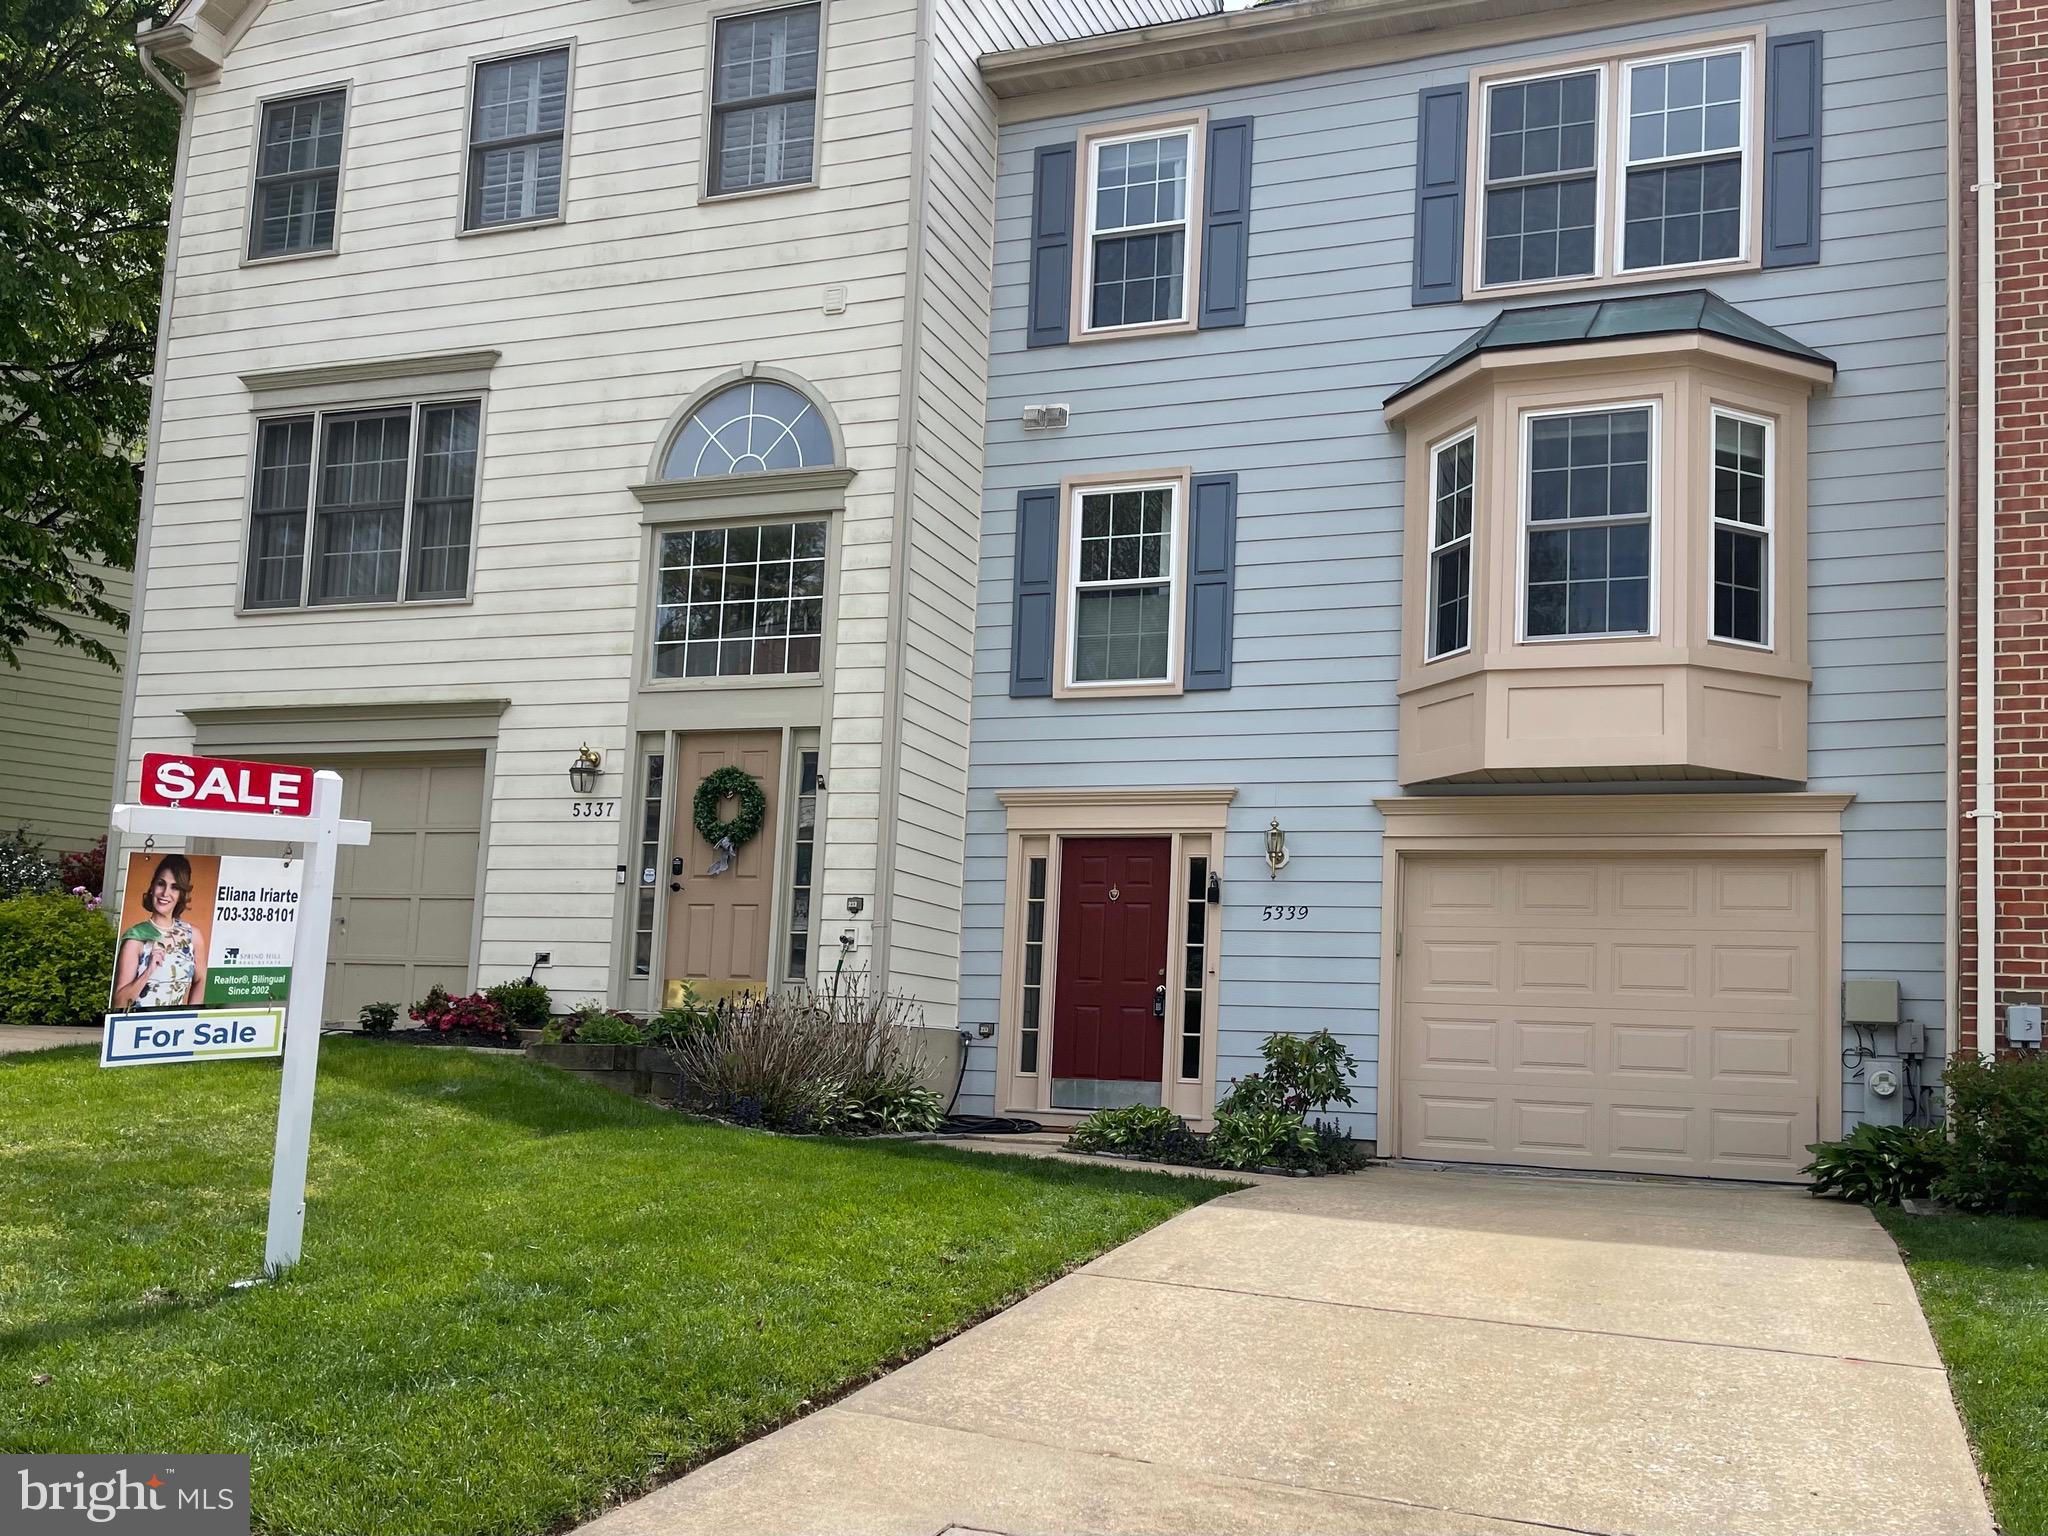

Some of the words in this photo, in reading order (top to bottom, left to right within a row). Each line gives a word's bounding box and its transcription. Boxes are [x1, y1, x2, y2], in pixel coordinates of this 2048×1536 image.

[154, 762, 302, 807] SALE
[572, 802, 615, 817] 5337
[217, 886, 256, 902] Eliana
[260, 887, 298, 903] Iriarte
[216, 907, 295, 922] 703-338-8101
[1262, 905, 1309, 922] 5339
[252, 974, 286, 985] Bilingual
[228, 986, 250, 995] Since
[251, 985, 270, 995] 2002
[133, 1025, 184, 1049] For
[193, 1021, 257, 1046] Sale
